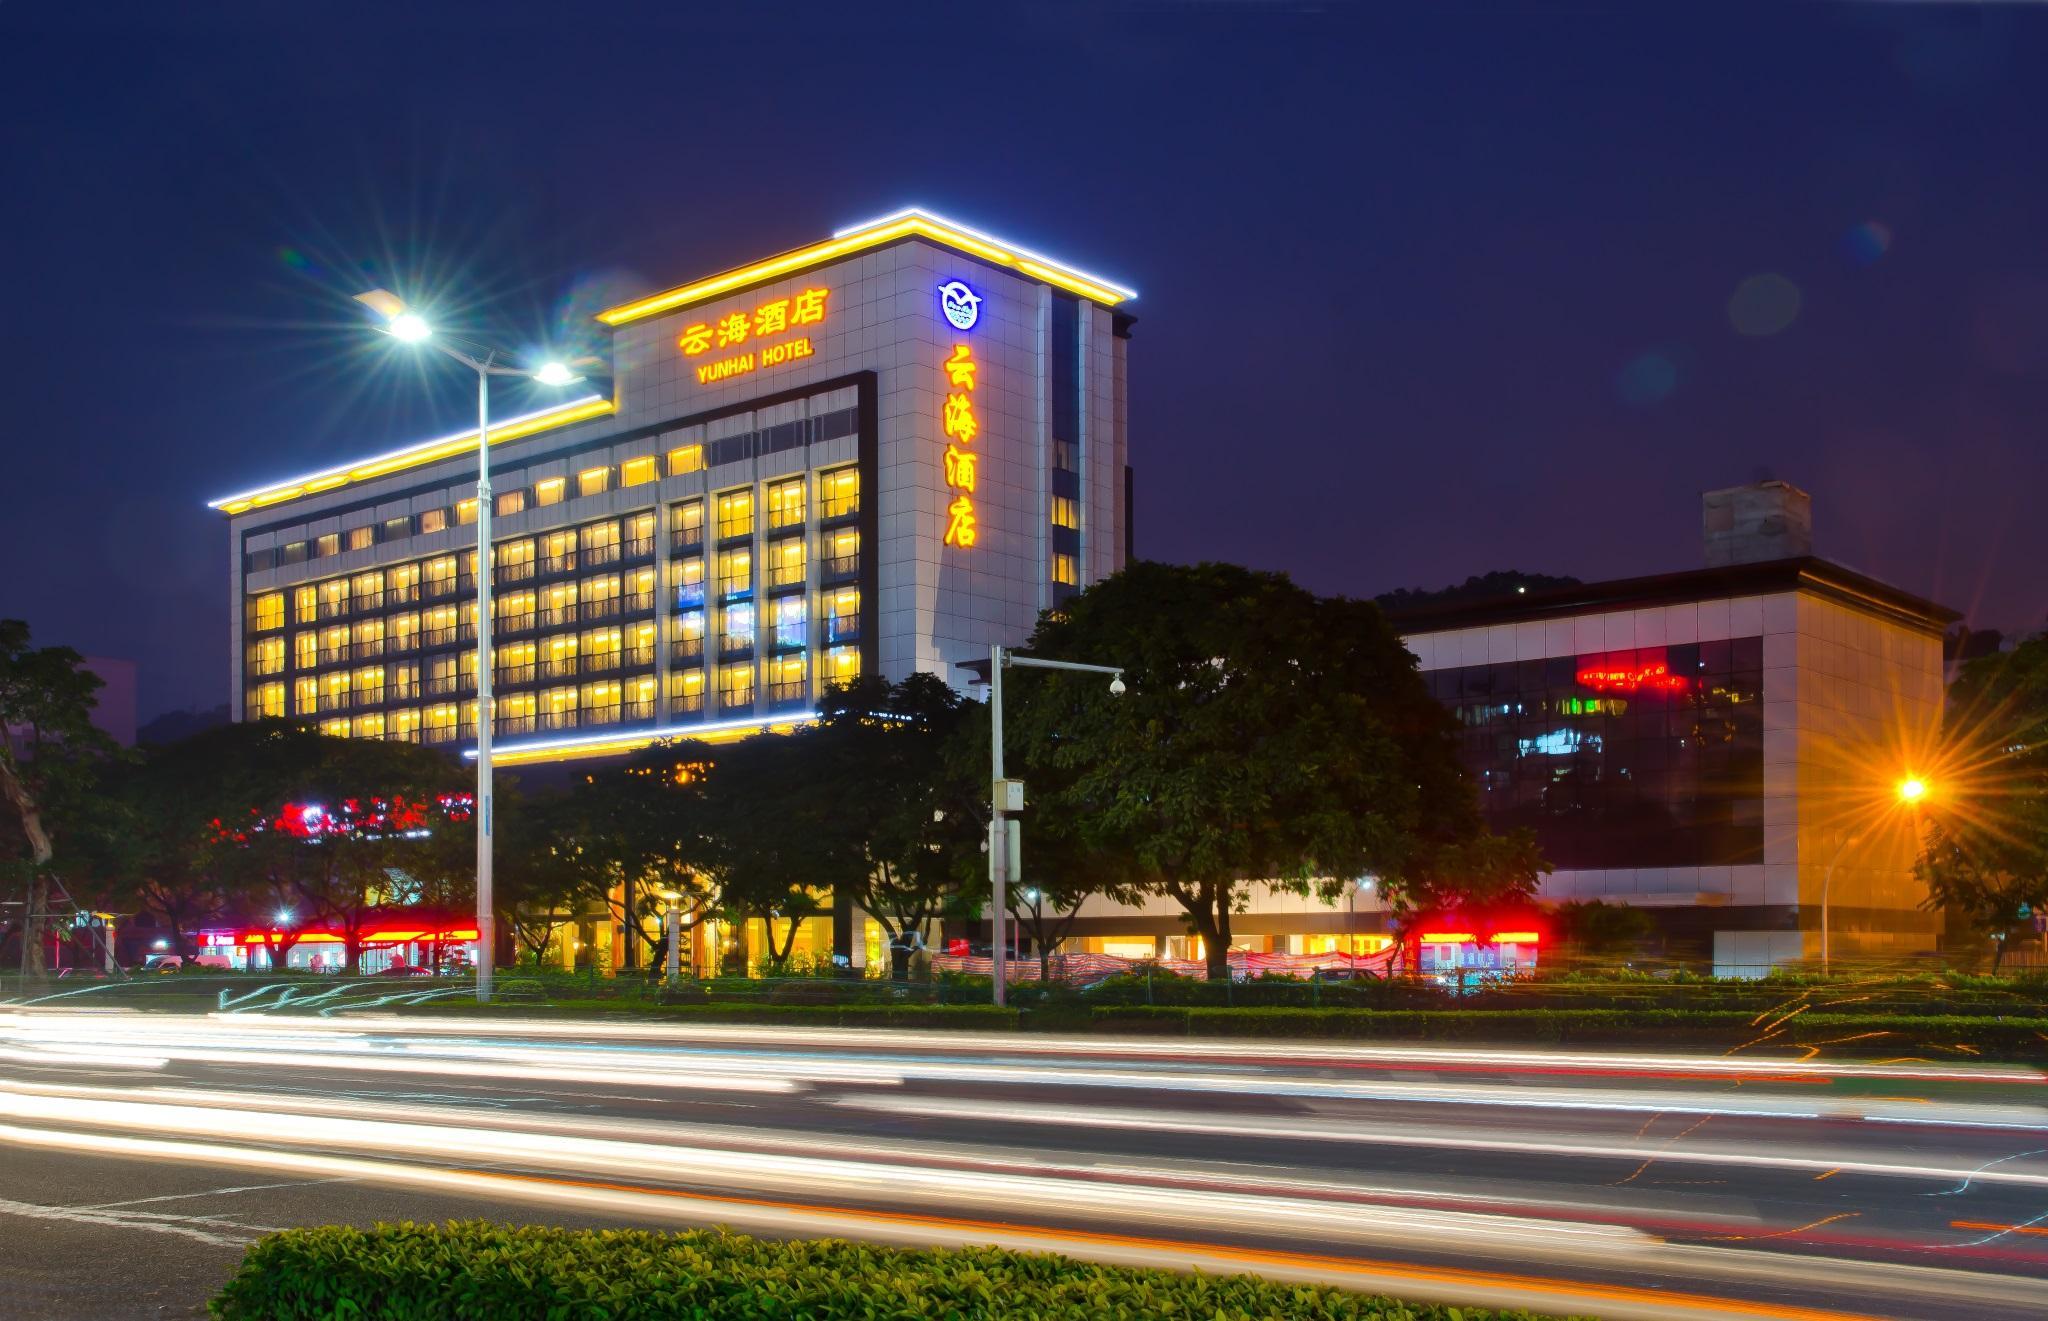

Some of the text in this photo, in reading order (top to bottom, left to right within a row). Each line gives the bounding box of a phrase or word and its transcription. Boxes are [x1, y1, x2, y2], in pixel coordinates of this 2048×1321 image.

[679, 288, 829, 355] 云海酒店
[697, 337, 815, 385] YUNHAI HOTEL
[944, 343, 977, 546] 云海酒店
